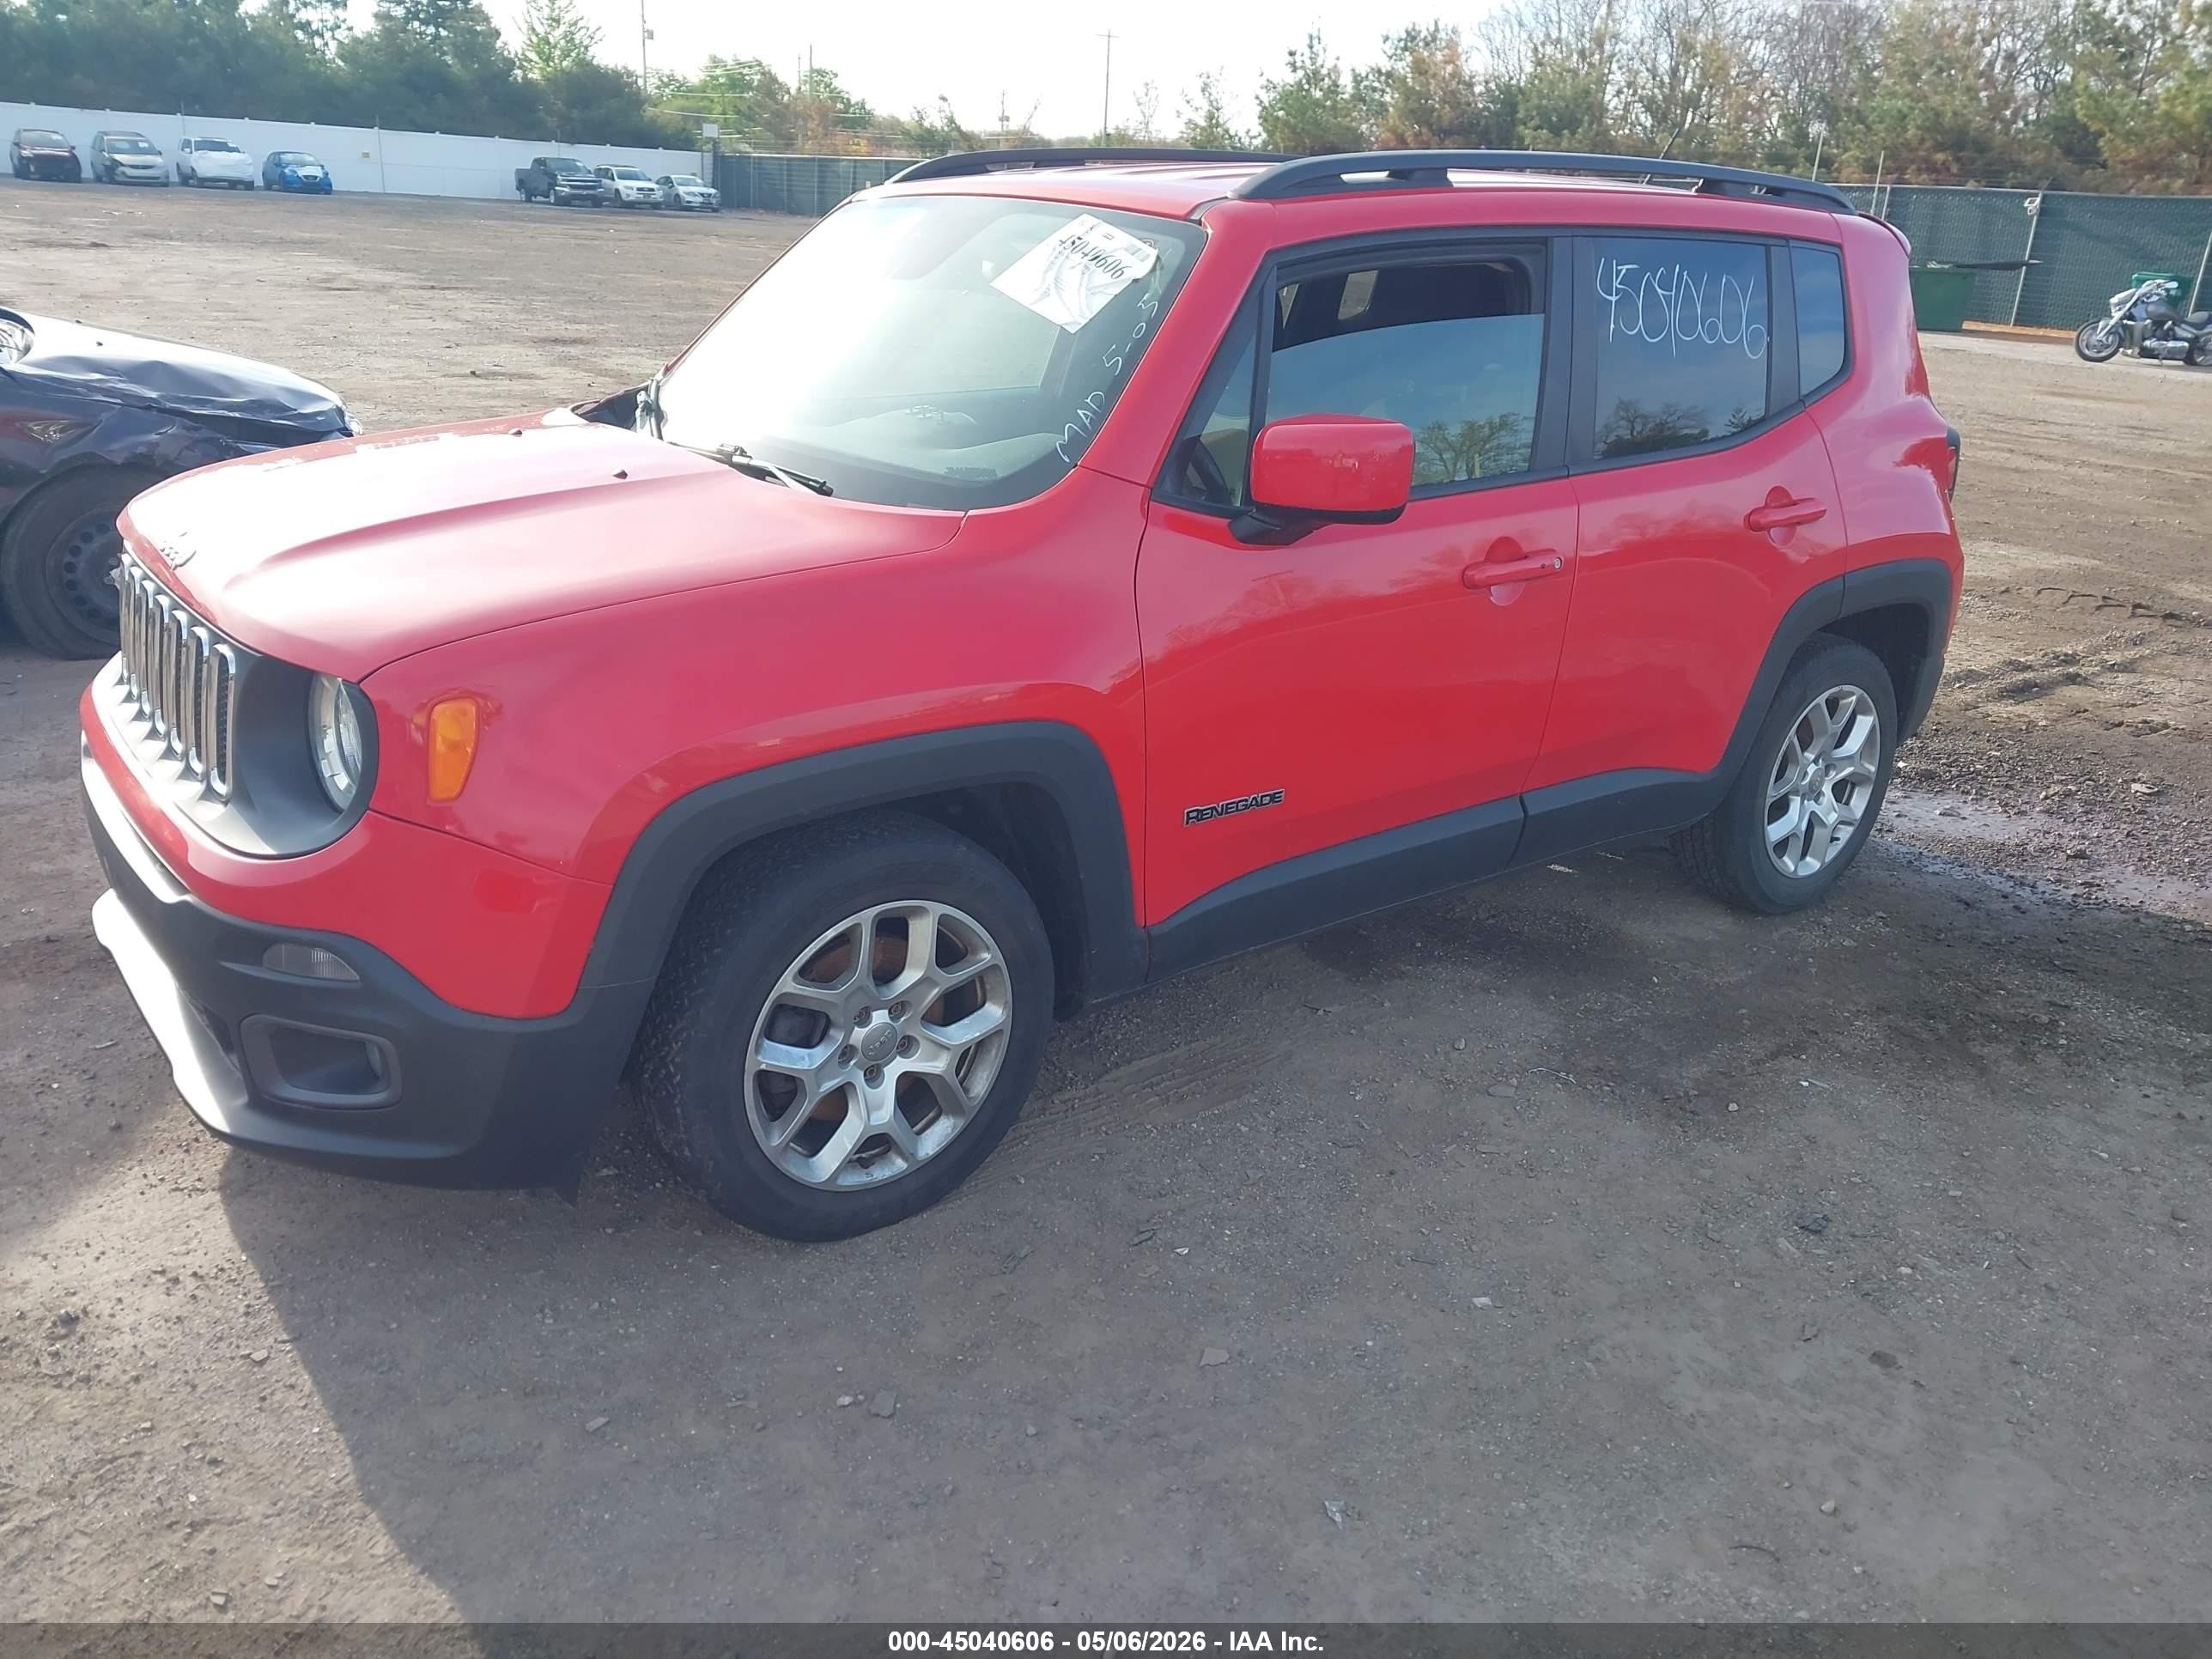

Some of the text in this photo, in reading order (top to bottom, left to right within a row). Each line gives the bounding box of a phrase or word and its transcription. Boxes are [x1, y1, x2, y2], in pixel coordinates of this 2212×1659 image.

[1596, 257, 1767, 359] 45040606
[1055, 390, 1105, 463] MAD
[1183, 788, 1285, 827] RENEGADE
